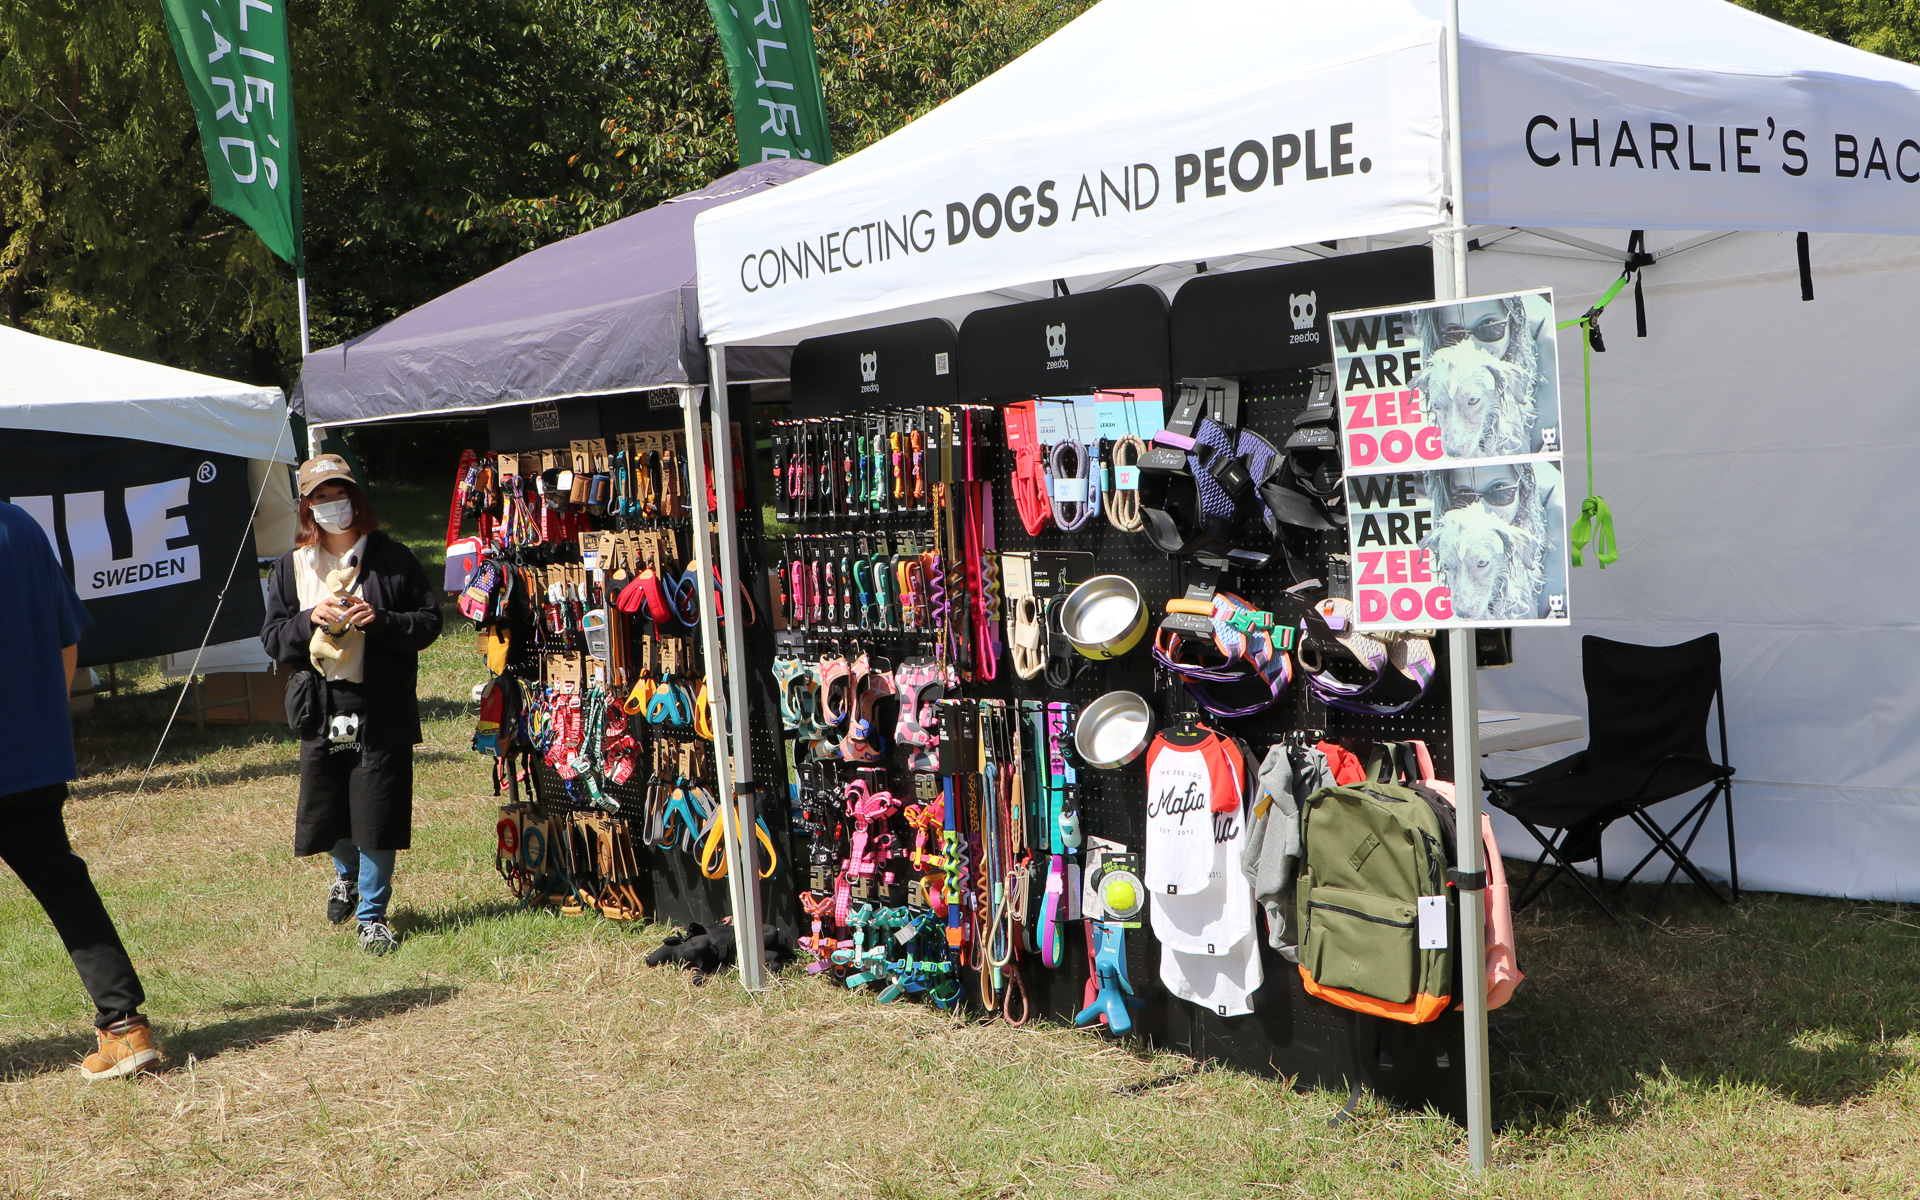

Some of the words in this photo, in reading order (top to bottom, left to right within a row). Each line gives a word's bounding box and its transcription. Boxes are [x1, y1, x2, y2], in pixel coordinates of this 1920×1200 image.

[1525, 113, 1809, 178] CHARLIE'S
[1834, 133, 1920, 184] BAC
[741, 208, 936, 293] CONNECTING
[945, 179, 1059, 247] DOGS
[1071, 162, 1160, 222] AND
[1174, 121, 1373, 204] PEOPLE.
[1336, 313, 1407, 354] WE
[1345, 389, 1423, 430] ZEE
[1348, 426, 1446, 467] DOG
[1350, 473, 1417, 510] WE
[91, 556, 186, 590] SWEDEN
[1357, 549, 1432, 585] ZEE
[1358, 586, 1455, 622] DOG
[1147, 781, 1206, 826] Mafia
